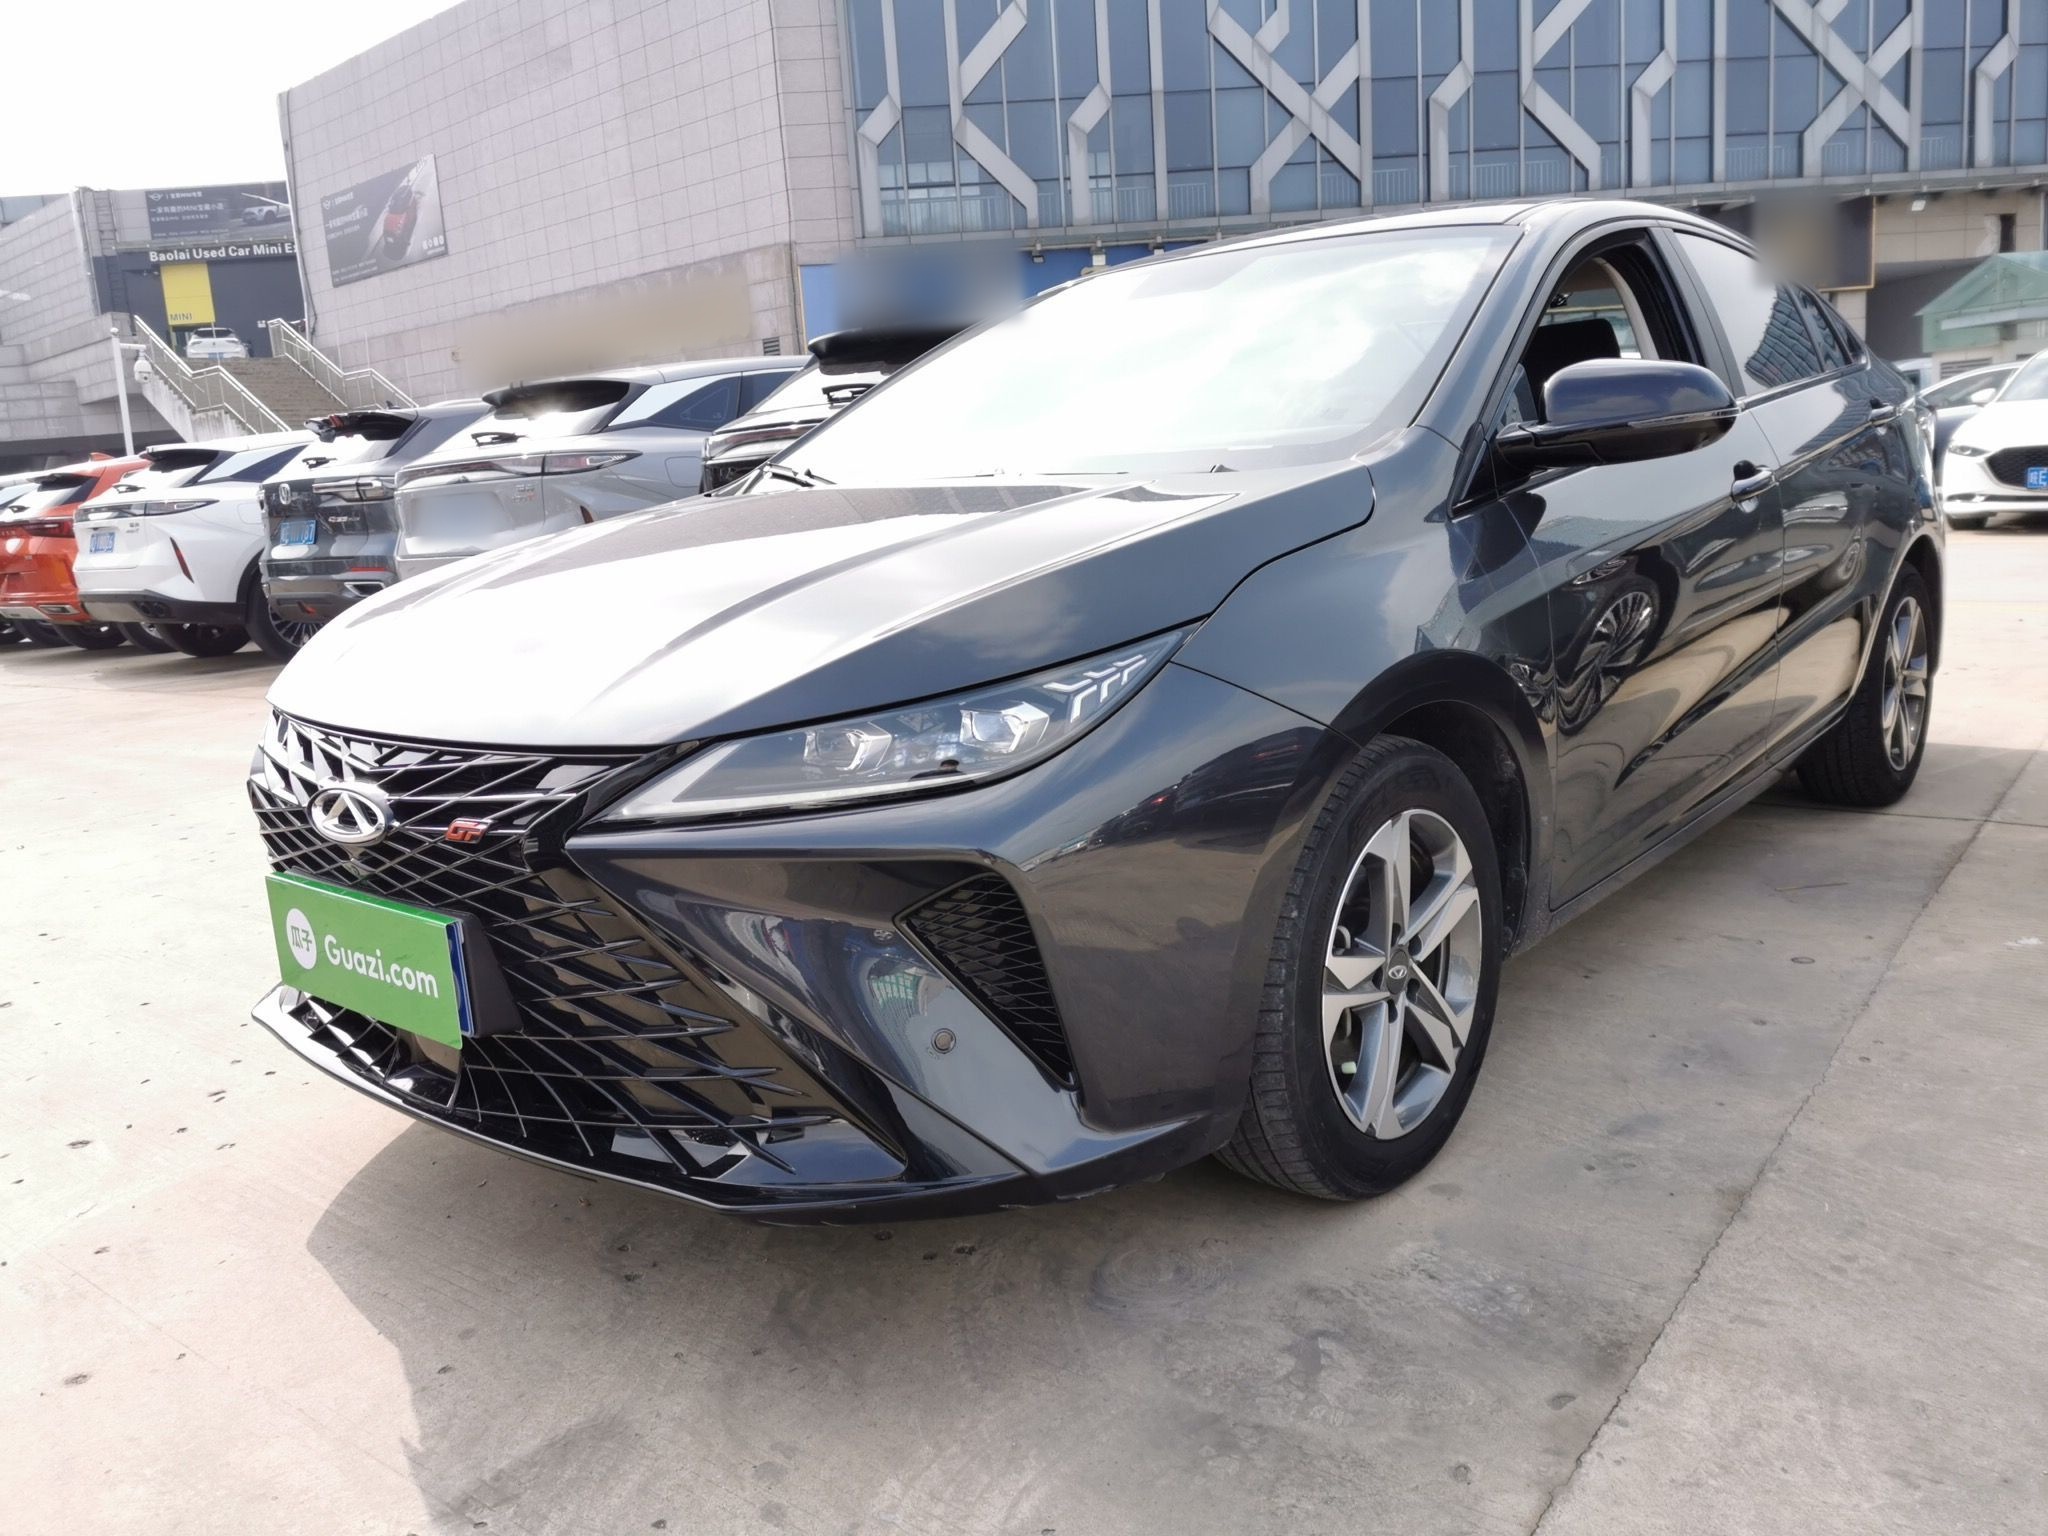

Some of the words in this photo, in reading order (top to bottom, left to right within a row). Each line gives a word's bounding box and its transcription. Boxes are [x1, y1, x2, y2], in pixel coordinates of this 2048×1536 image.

[150, 250, 190, 262] Baolai
[193, 247, 225, 259] Used
[228, 245, 251, 257] Car
[254, 243, 282, 255] Mini
[170, 313, 192, 321] MINI
[291, 925, 312, 952] 瓜子
[324, 934, 439, 998] Guazi.com
